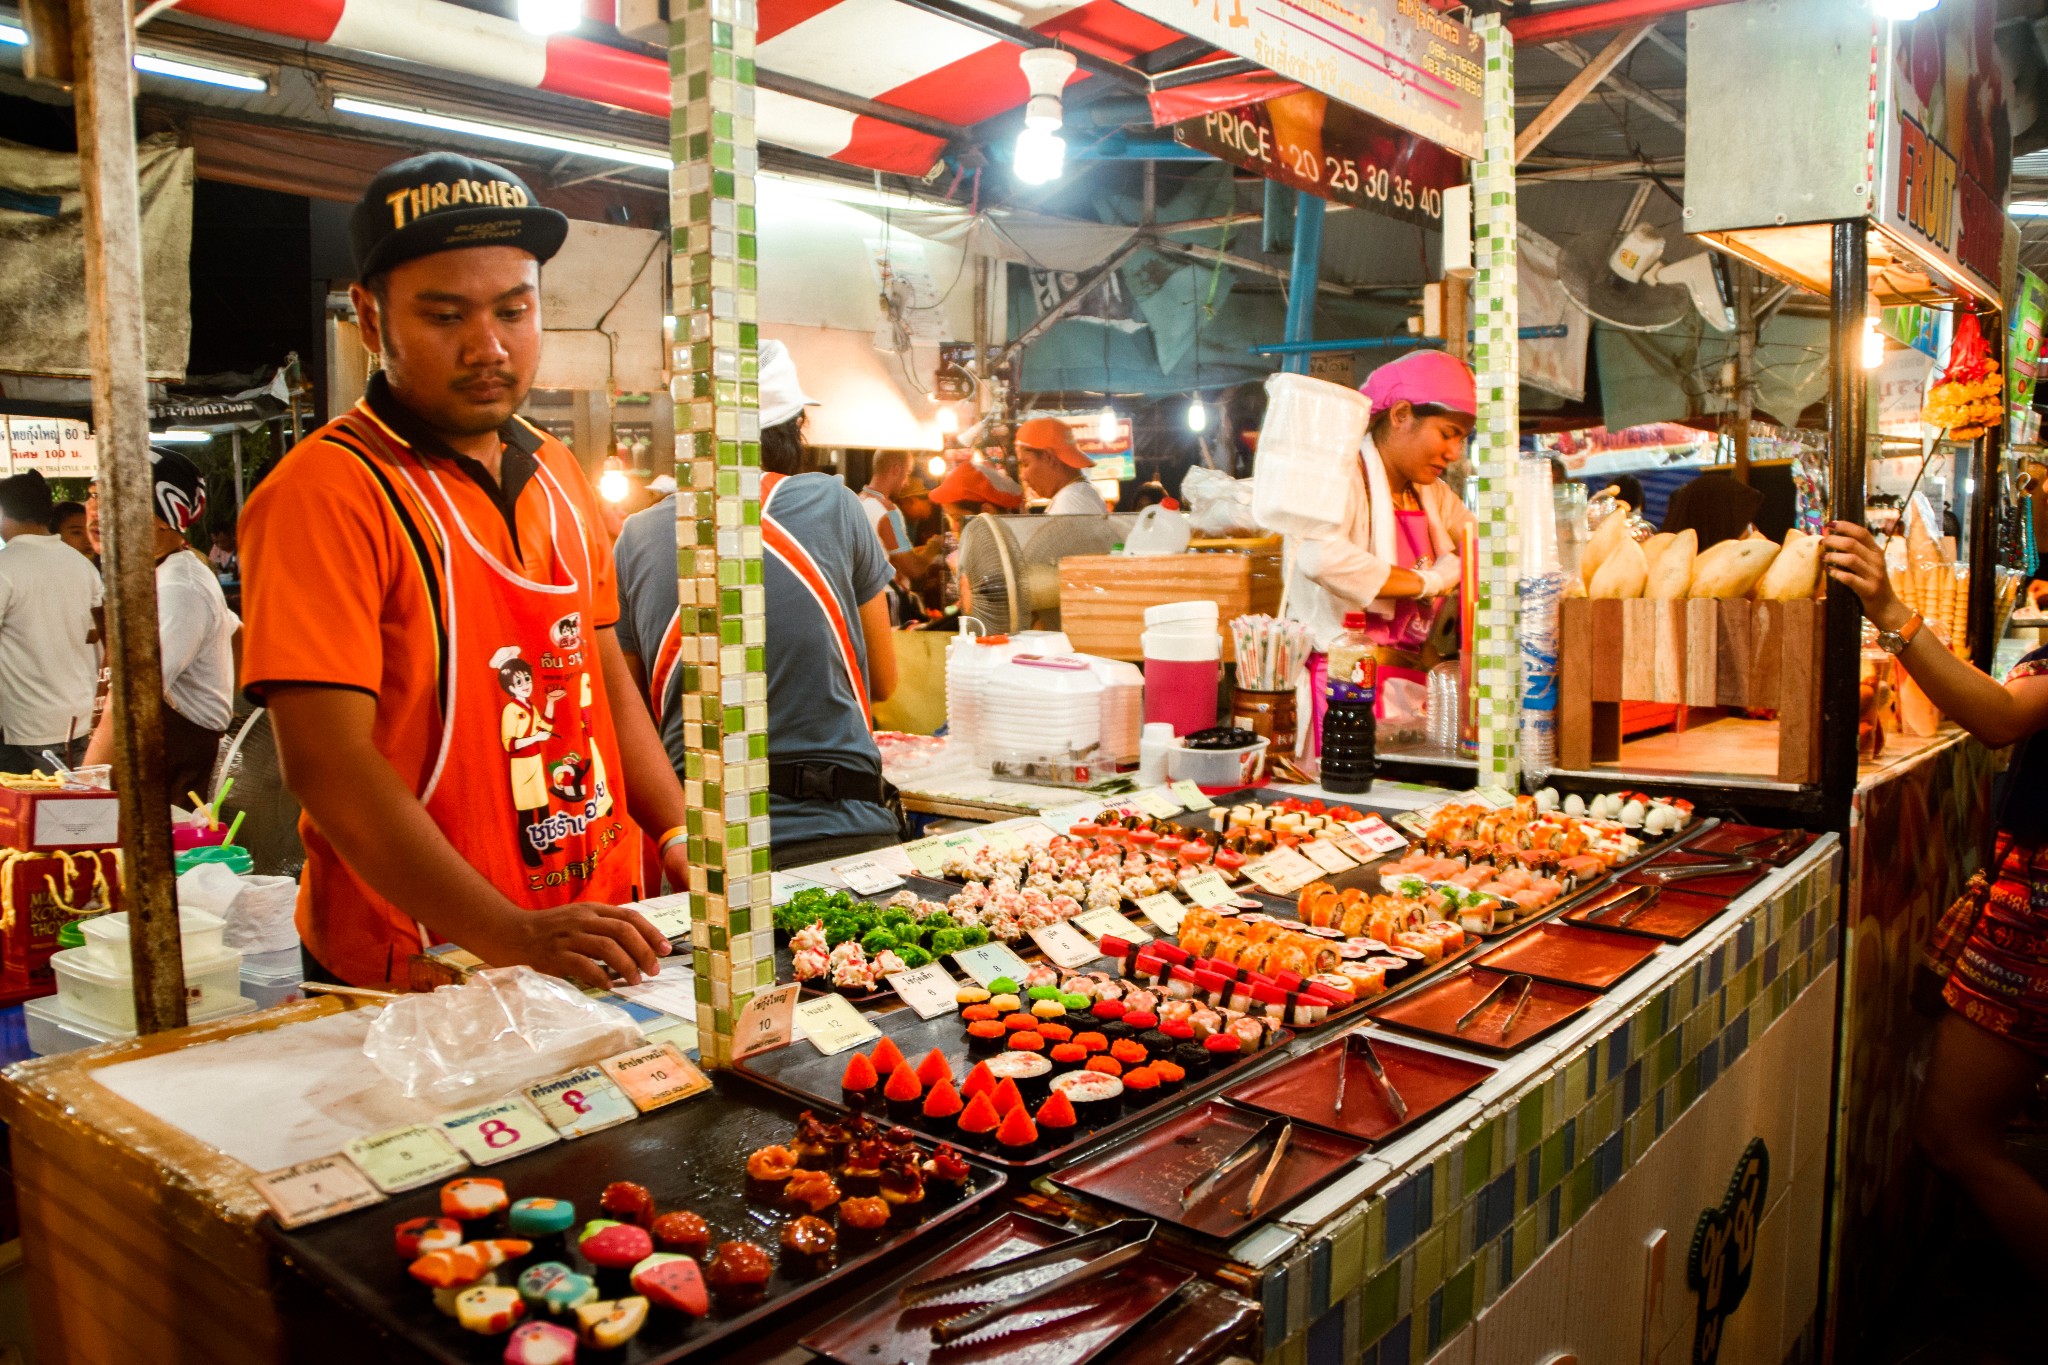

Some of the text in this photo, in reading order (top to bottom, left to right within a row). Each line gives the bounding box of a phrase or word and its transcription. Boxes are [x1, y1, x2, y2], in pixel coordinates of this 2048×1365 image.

[1205, 112, 1441, 220] PRICE 20 25 30 35 40
[1897, 109, 1957, 254] FRUIT
[65, 428, 79, 440] 60
[45, 449, 66, 459] 100
[759, 1017, 771, 1031] 10
[827, 1018, 843, 1029] 12
[650, 1070, 668, 1082] 10
[478, 1118, 522, 1149] 8
